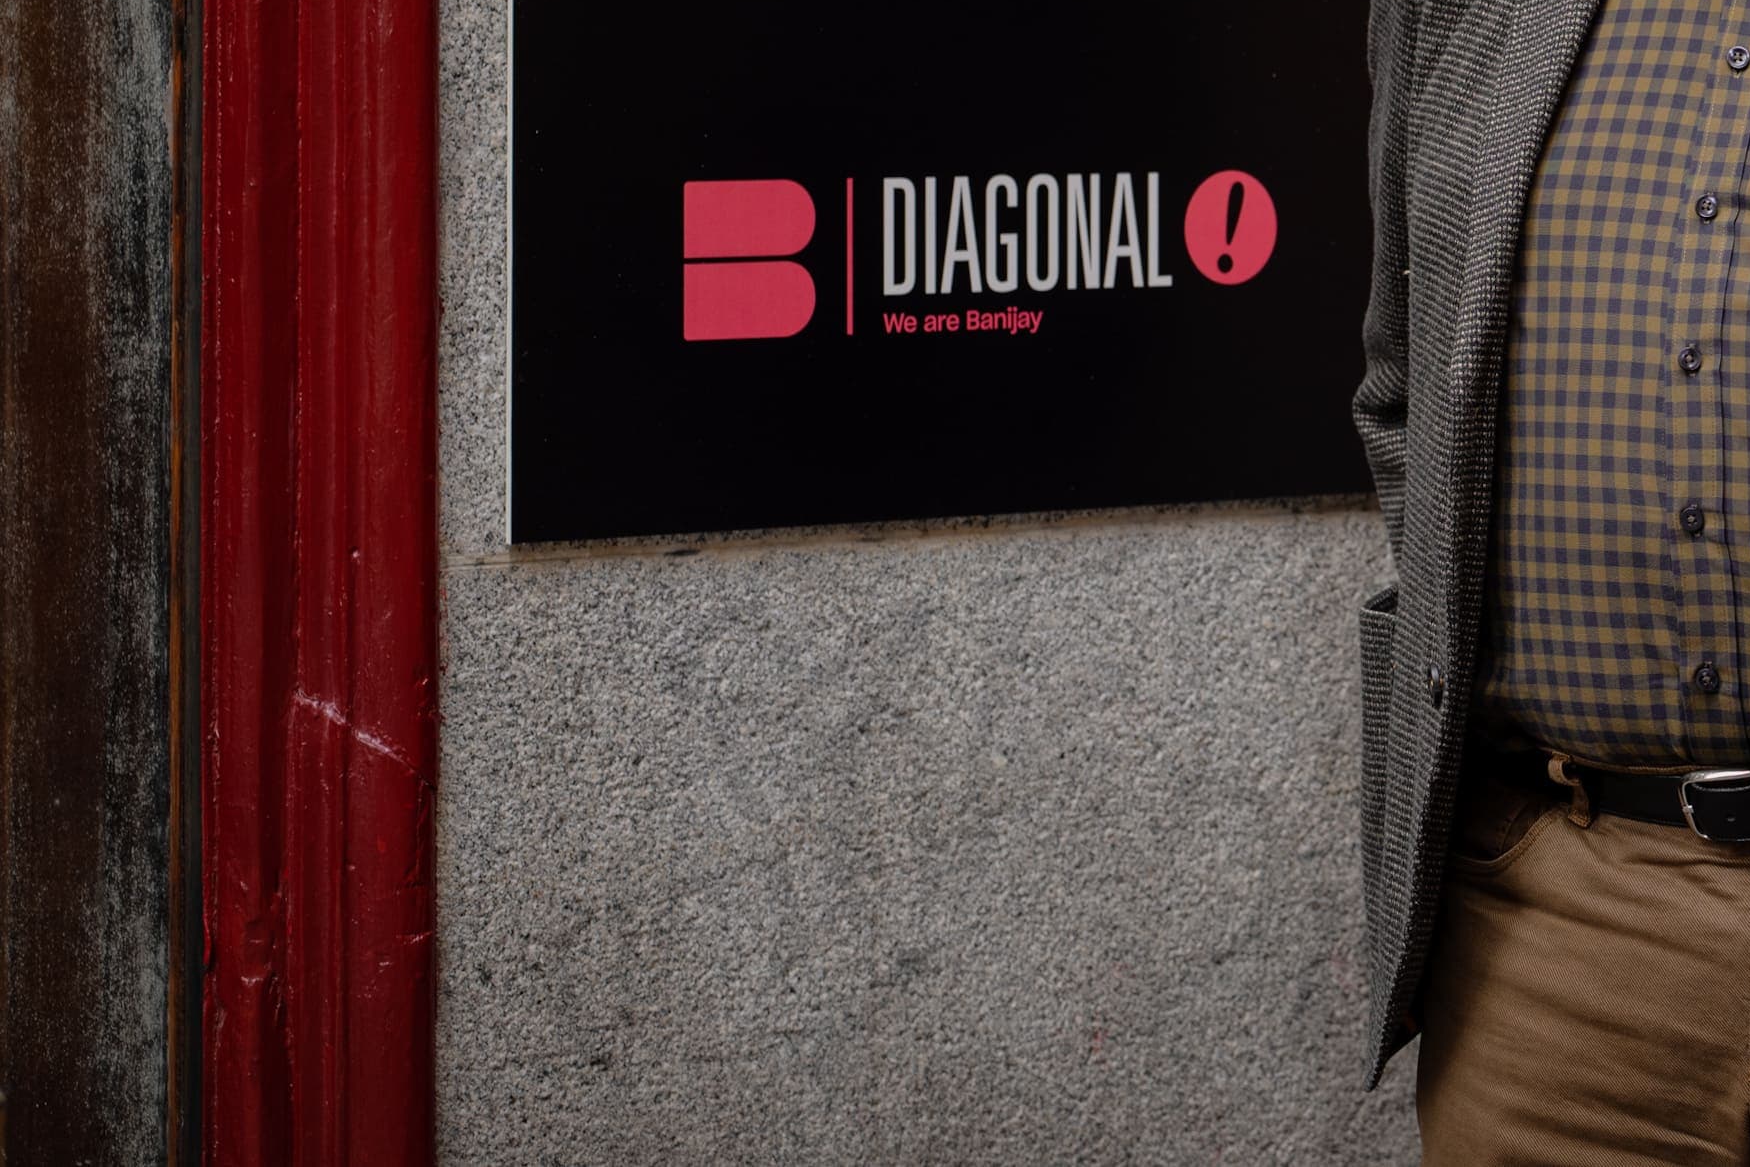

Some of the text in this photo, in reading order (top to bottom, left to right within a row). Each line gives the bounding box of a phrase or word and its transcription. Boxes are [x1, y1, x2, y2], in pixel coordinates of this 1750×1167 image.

[883, 172, 1173, 296] DIAGONAL
[882, 306, 1043, 335] We are Banijay
